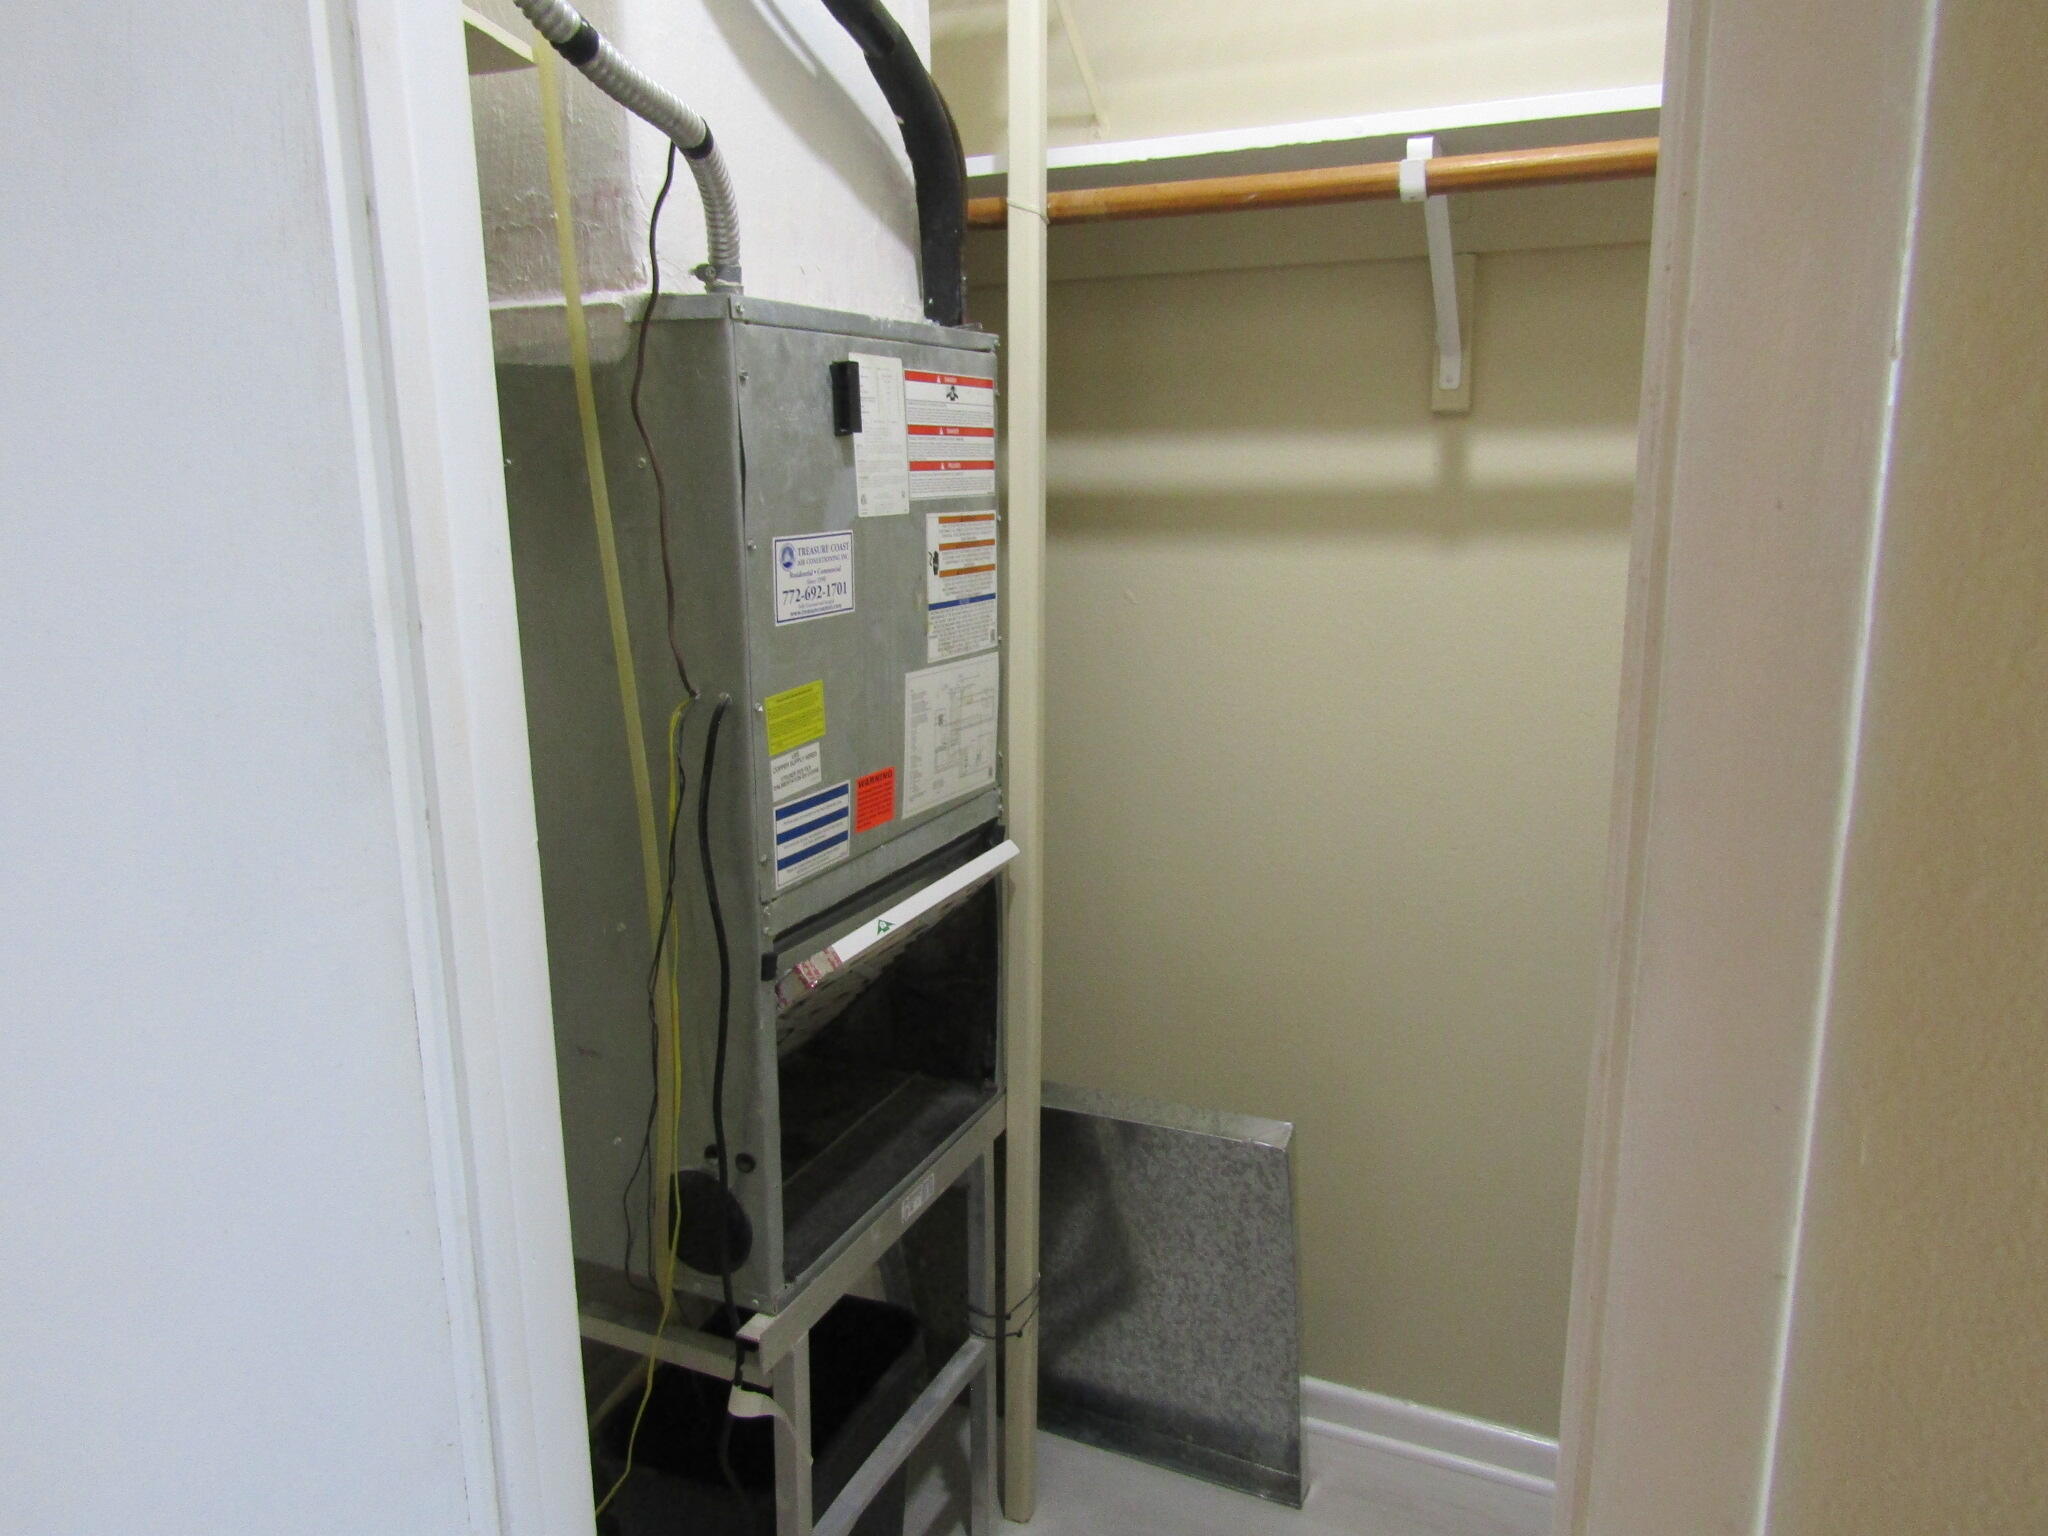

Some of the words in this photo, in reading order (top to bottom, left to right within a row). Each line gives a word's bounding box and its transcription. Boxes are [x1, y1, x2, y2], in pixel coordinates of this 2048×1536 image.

[798, 545, 829, 556] TREASURE
[830, 542, 849, 552] COAST
[782, 582, 847, 606] 772-692-1701
[858, 770, 893, 788] WARNING
